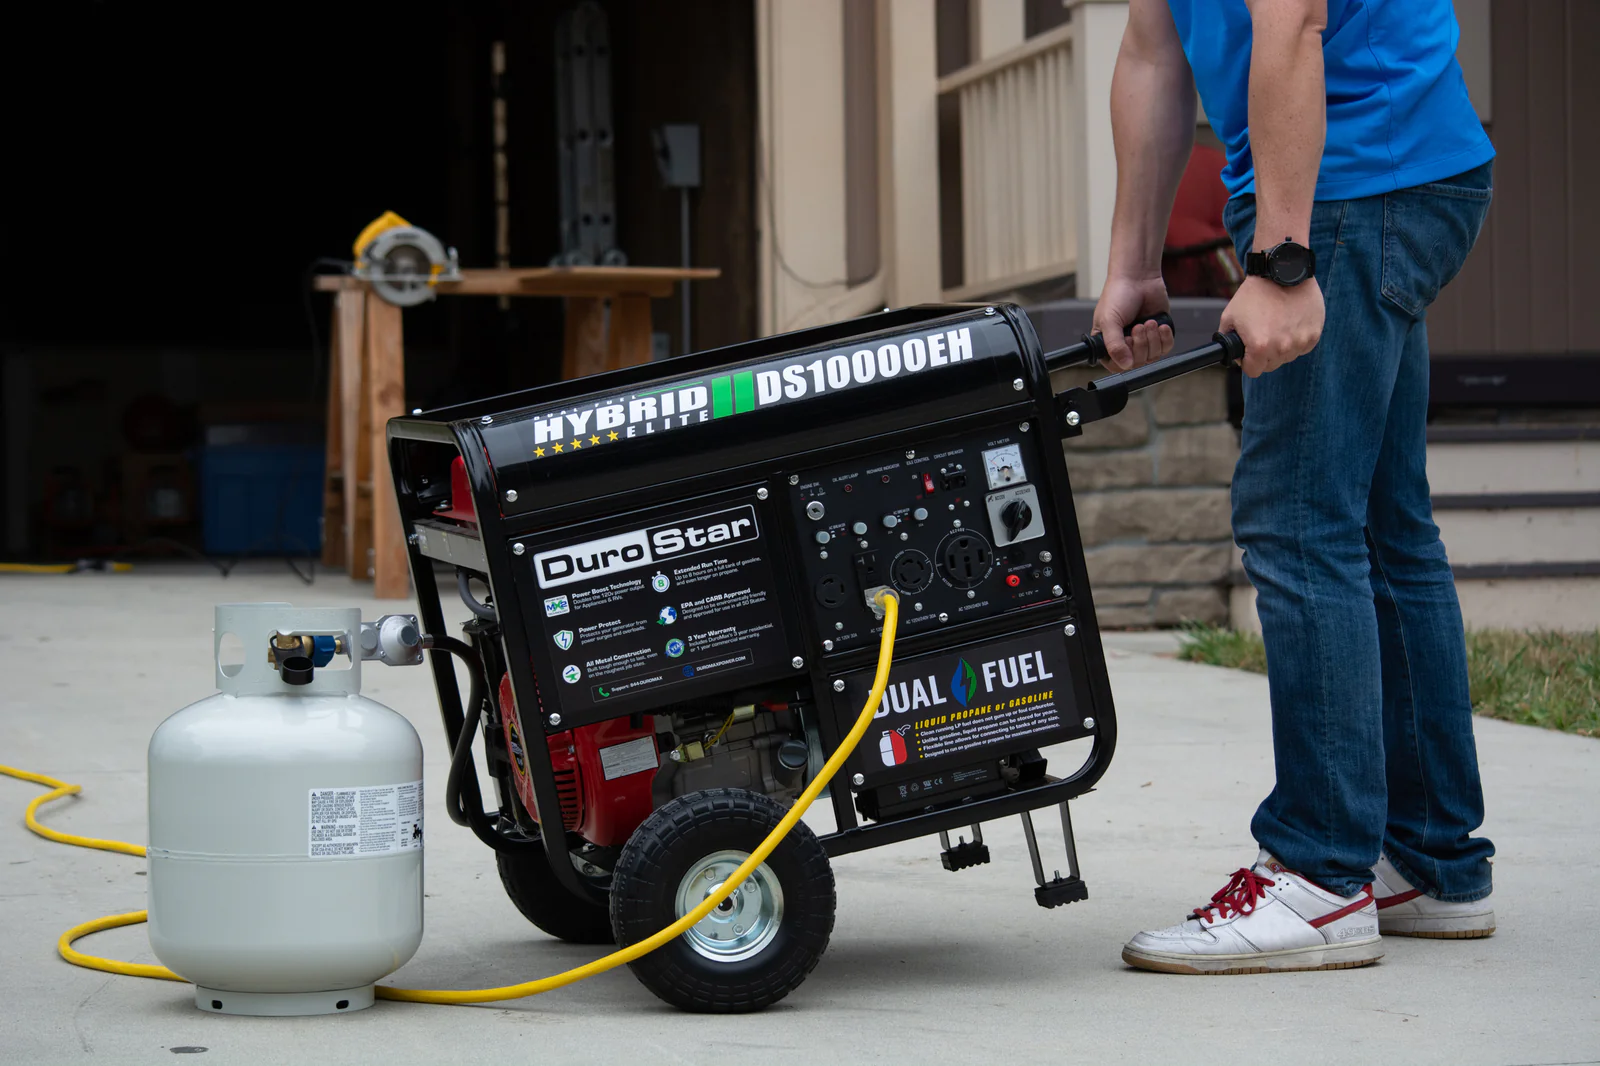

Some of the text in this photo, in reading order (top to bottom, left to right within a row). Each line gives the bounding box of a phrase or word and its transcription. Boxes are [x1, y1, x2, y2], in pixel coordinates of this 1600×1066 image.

[756, 328, 972, 405] DS10000EH
[534, 386, 708, 444] HYBRID
[626, 410, 708, 438] ELITE
[541, 518, 750, 582] Duro Star
[674, 564, 700, 575] Extended
[609, 579, 641, 590] Technology
[657, 579, 665, 588] 8
[614, 588, 628, 596] power
[705, 594, 722, 603] CARB
[723, 588, 751, 599] Approved
[582, 599, 607, 608] Appliances
[693, 608, 714, 618] approved
[598, 619, 621, 628] Protect
[707, 626, 736, 636] Warranty
[595, 656, 612, 665] Metal
[613, 648, 651, 660] Construction
[868, 650, 1053, 719] DUAL FUEL
[915, 690, 1053, 729] LIQUID PROPANE or GASOLINE
[1028, 702, 1054, 711] carburetor.
[923, 742, 943, 750] Flexible
[980, 727, 1009, 737] connecting
[939, 732, 962, 741] gasoline,
[977, 723, 998, 732] propane
[924, 749, 944, 758] Designed
[964, 741, 981, 750] gasoline
[987, 736, 1004, 744] propane
[1011, 729, 1032, 737] maximum
[1032, 723, 1060, 732] convenience.
